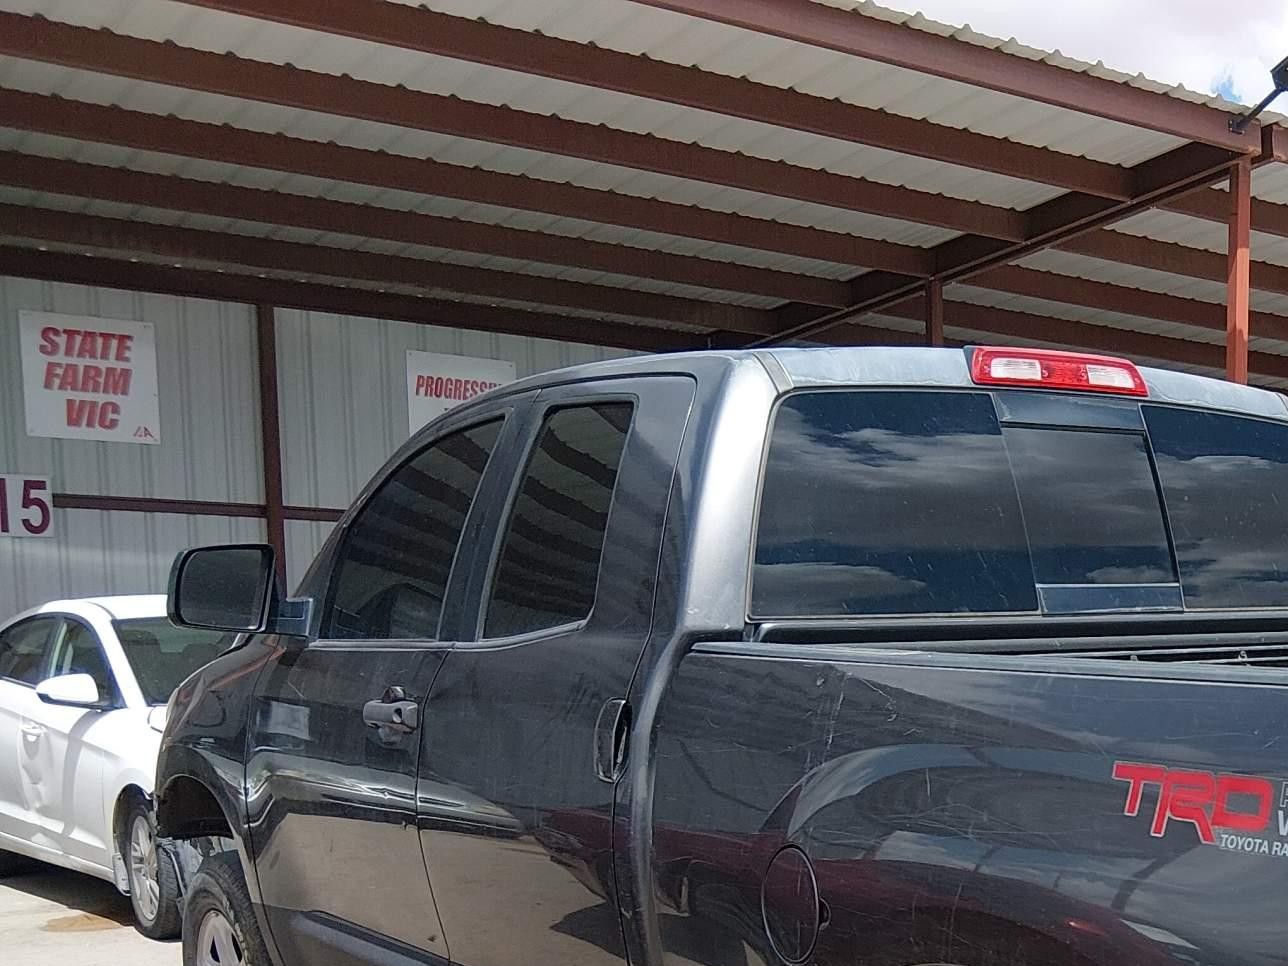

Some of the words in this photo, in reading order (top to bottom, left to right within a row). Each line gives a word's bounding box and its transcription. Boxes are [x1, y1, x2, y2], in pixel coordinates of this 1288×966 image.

[39, 326, 134, 363] STATE
[44, 361, 133, 396] FARM
[415, 374, 502, 401] PROGRESS
[65, 398, 121, 430] VIC
[1112, 761, 1275, 844] TRD
[1220, 834, 1270, 854] TOYOTA
